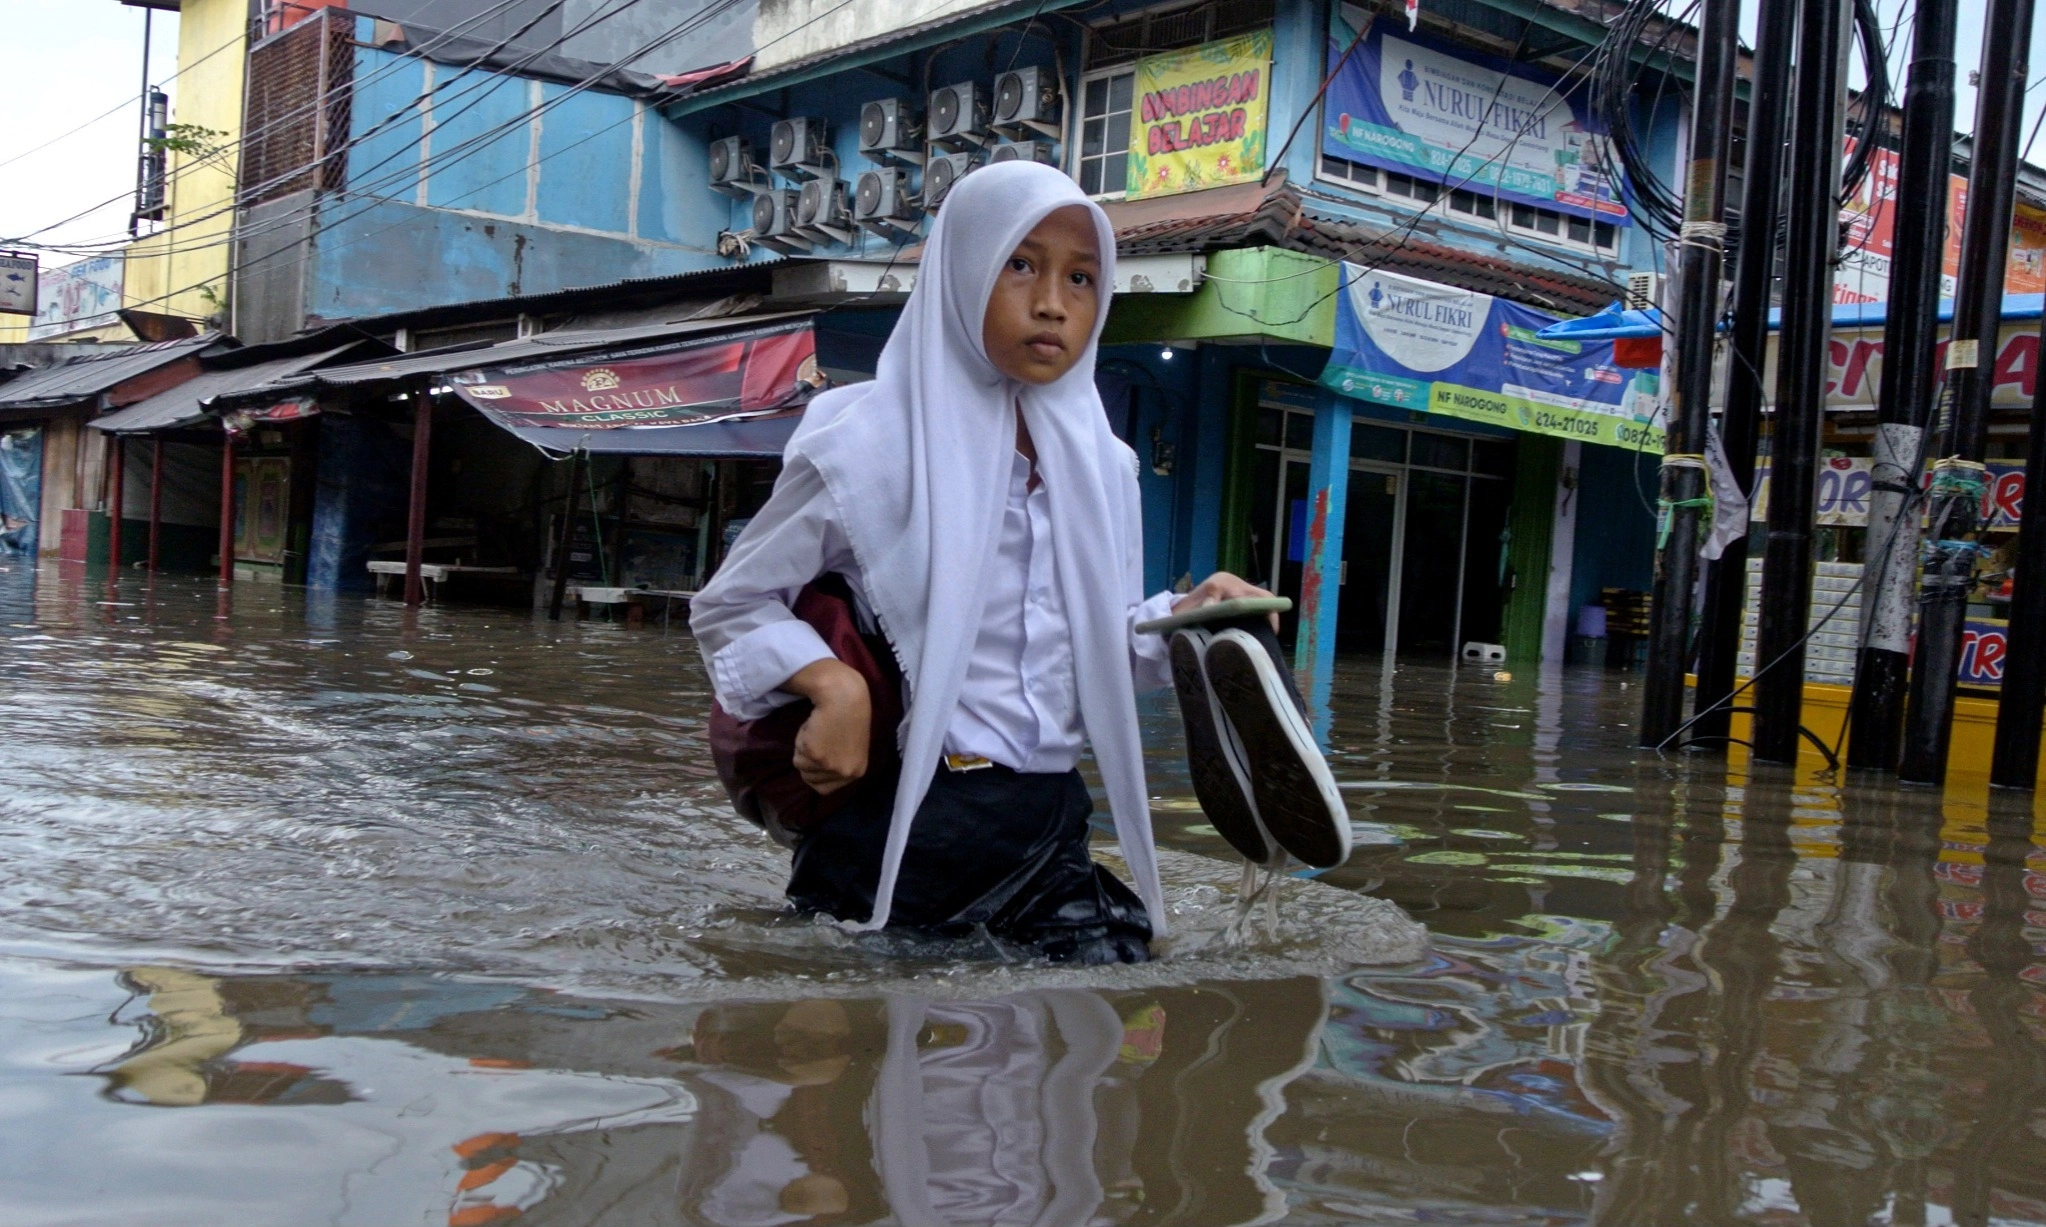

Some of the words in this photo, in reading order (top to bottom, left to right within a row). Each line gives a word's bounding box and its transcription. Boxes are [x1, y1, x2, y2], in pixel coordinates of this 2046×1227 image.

[1141, 68, 1260, 124] BIMBINGAN
[1423, 80, 1489, 125] NURUL
[1494, 102, 1548, 140] FIKRI
[1147, 107, 1247, 156] BELAJAR
[1387, 293, 1432, 320] NURUL
[1434, 304, 1473, 329] FIKRI
[472, 387, 504, 397] BARU
[538, 384, 683, 413] MAGNUM
[589, 377, 612, 389] 234
[581, 409, 669, 423] CLASSIC
[1437, 390, 1452, 403] NF
[1453, 393, 1507, 414] NAROGONG
[1535, 410, 1598, 436] 824-27025
